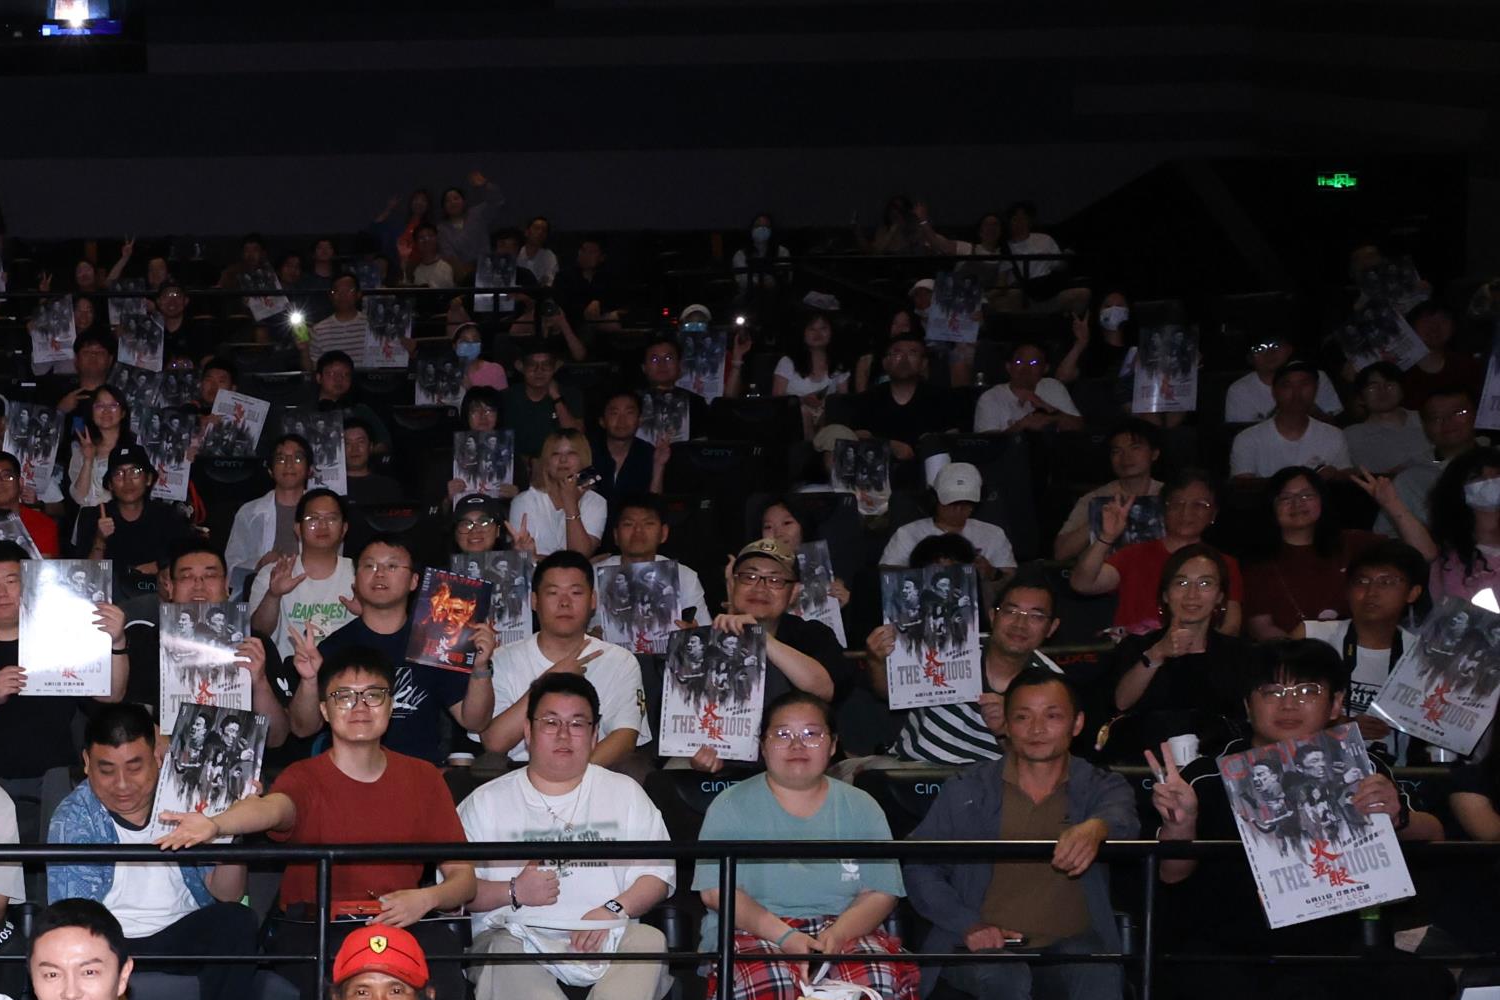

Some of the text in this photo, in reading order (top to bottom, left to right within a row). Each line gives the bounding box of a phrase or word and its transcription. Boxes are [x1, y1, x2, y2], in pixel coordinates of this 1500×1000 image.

[137, 580, 156, 592] CIN
[288, 602, 348, 620] JEANSWEST
[897, 665, 922, 686] THE
[1391, 683, 1422, 708] THE
[671, 713, 696, 734] THE
[913, 783, 941, 794] CIN
[1269, 842, 1391, 894] THE RIOUS
